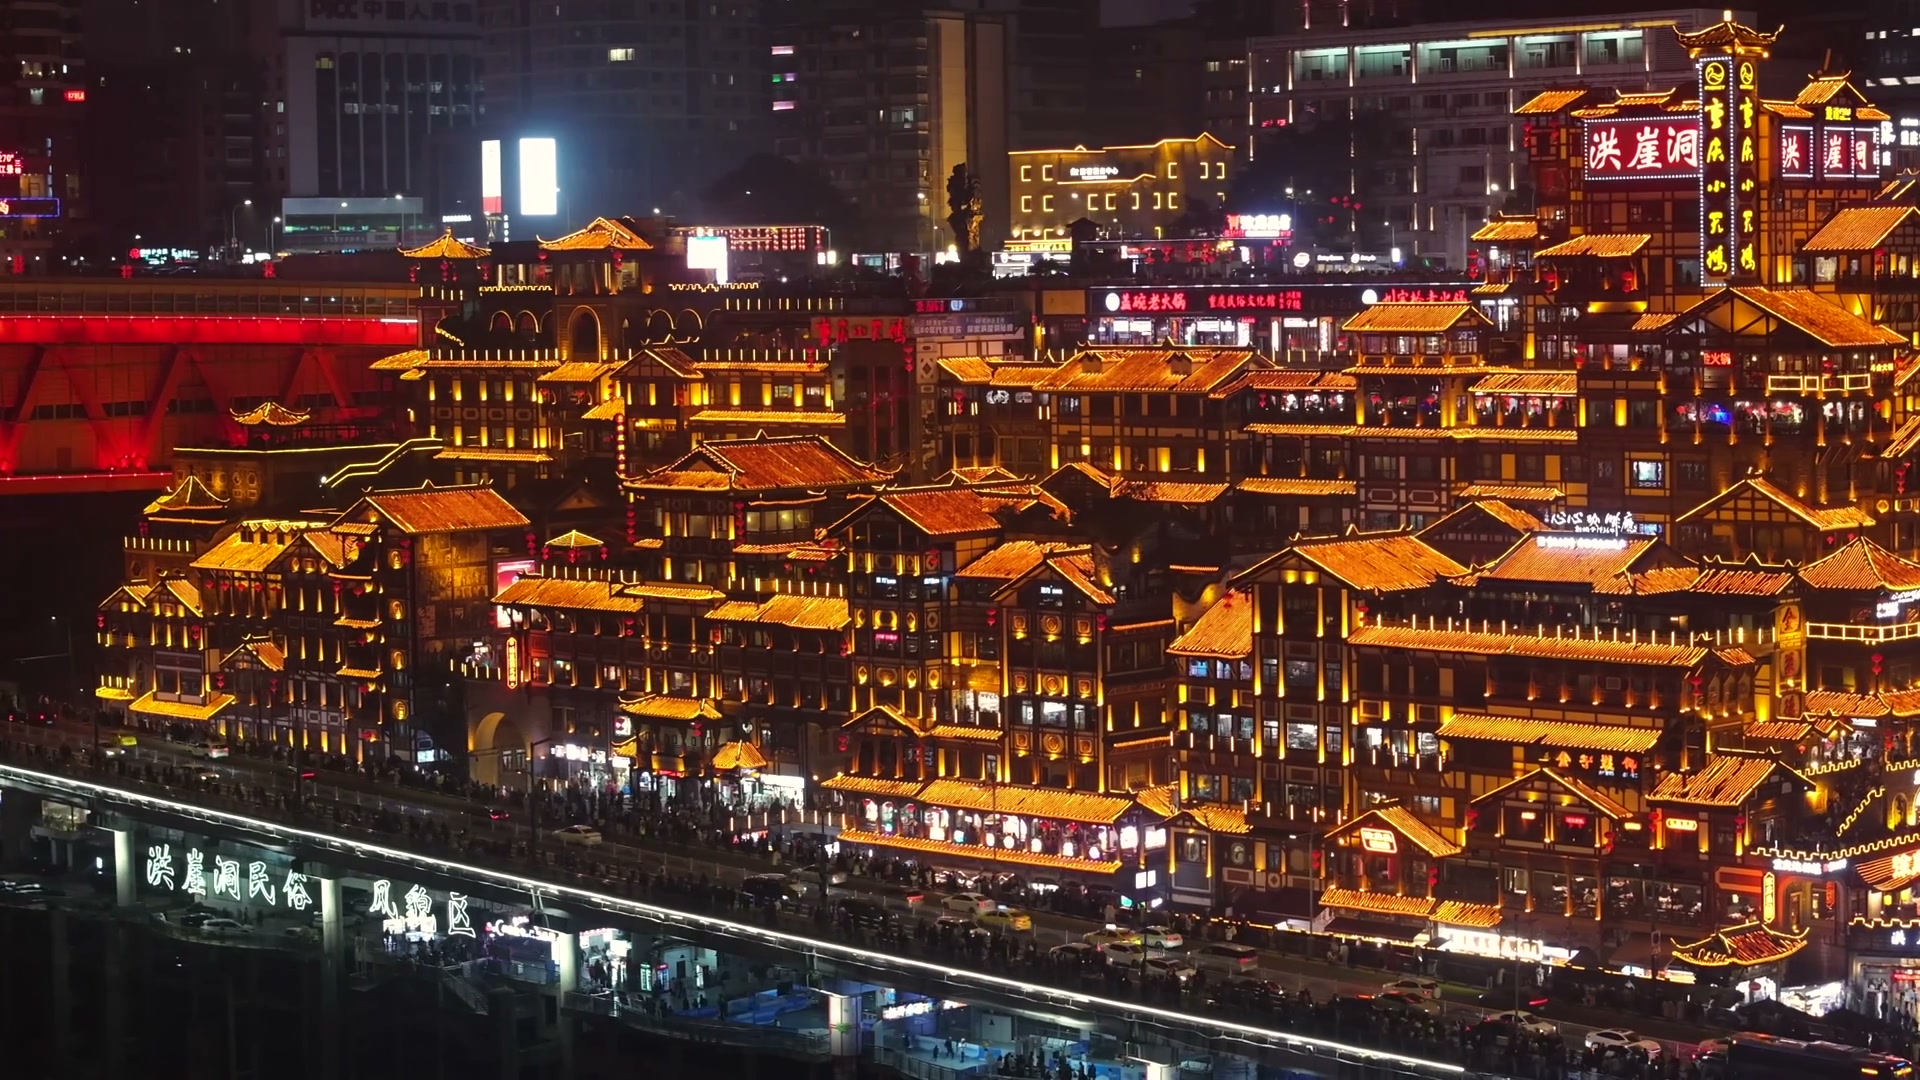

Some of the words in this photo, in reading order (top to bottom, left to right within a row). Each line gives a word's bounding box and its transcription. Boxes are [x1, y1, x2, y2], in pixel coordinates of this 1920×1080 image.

[1590, 126, 1698, 171] 洪崖洞
[1783, 134, 1867, 171] 洪崖洞
[1704, 97, 1728, 273] 重庆小天鹅
[1120, 292, 1186, 311] 盖碗老火锅
[146, 843, 312, 911] 洪崖洞民俗
